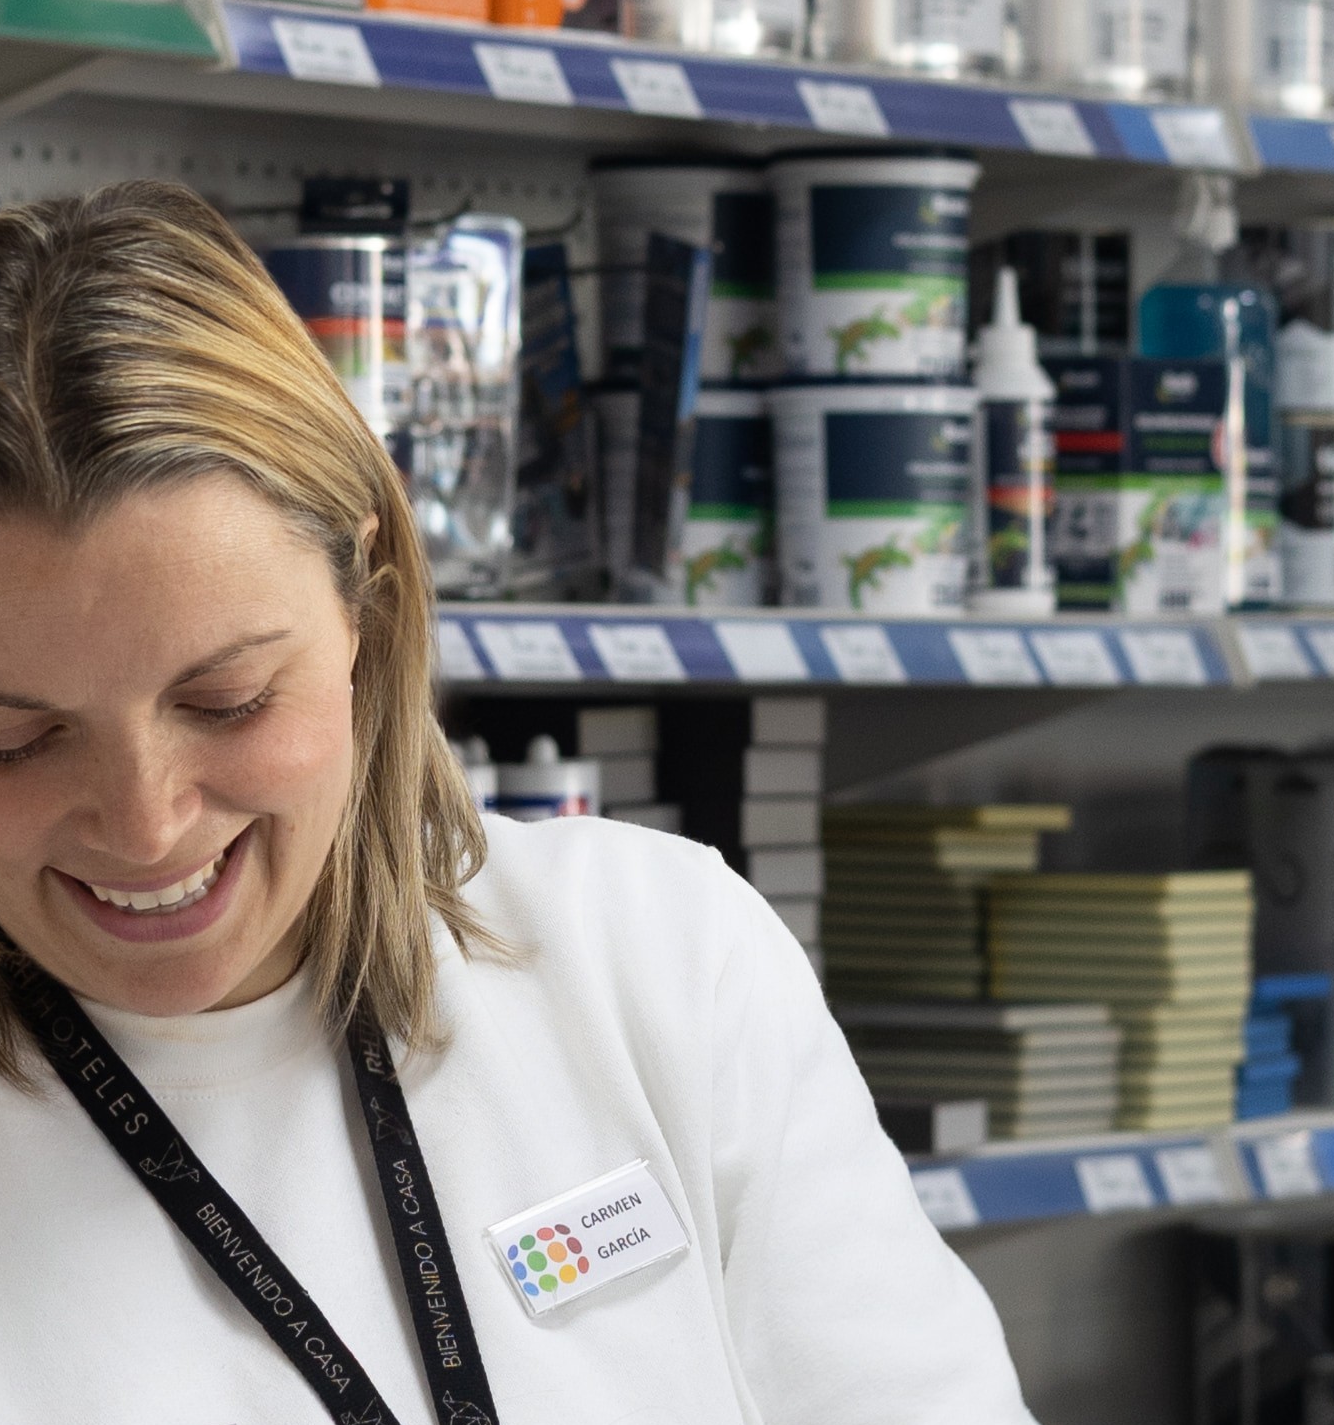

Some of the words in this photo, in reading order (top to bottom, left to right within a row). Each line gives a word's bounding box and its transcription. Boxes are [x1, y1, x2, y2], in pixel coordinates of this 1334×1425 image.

[393, 1159, 420, 1215] CASA
[410, 1221, 428, 1235] A
[581, 1192, 642, 1229] CARMEN
[597, 1227, 652, 1259] GARCÍA
[196, 1203, 294, 1317] BIENVENIDO
[289, 1320, 309, 1340] A
[305, 1337, 351, 1393] CASA
[415, 1242, 462, 1369] BIENVENIDO
